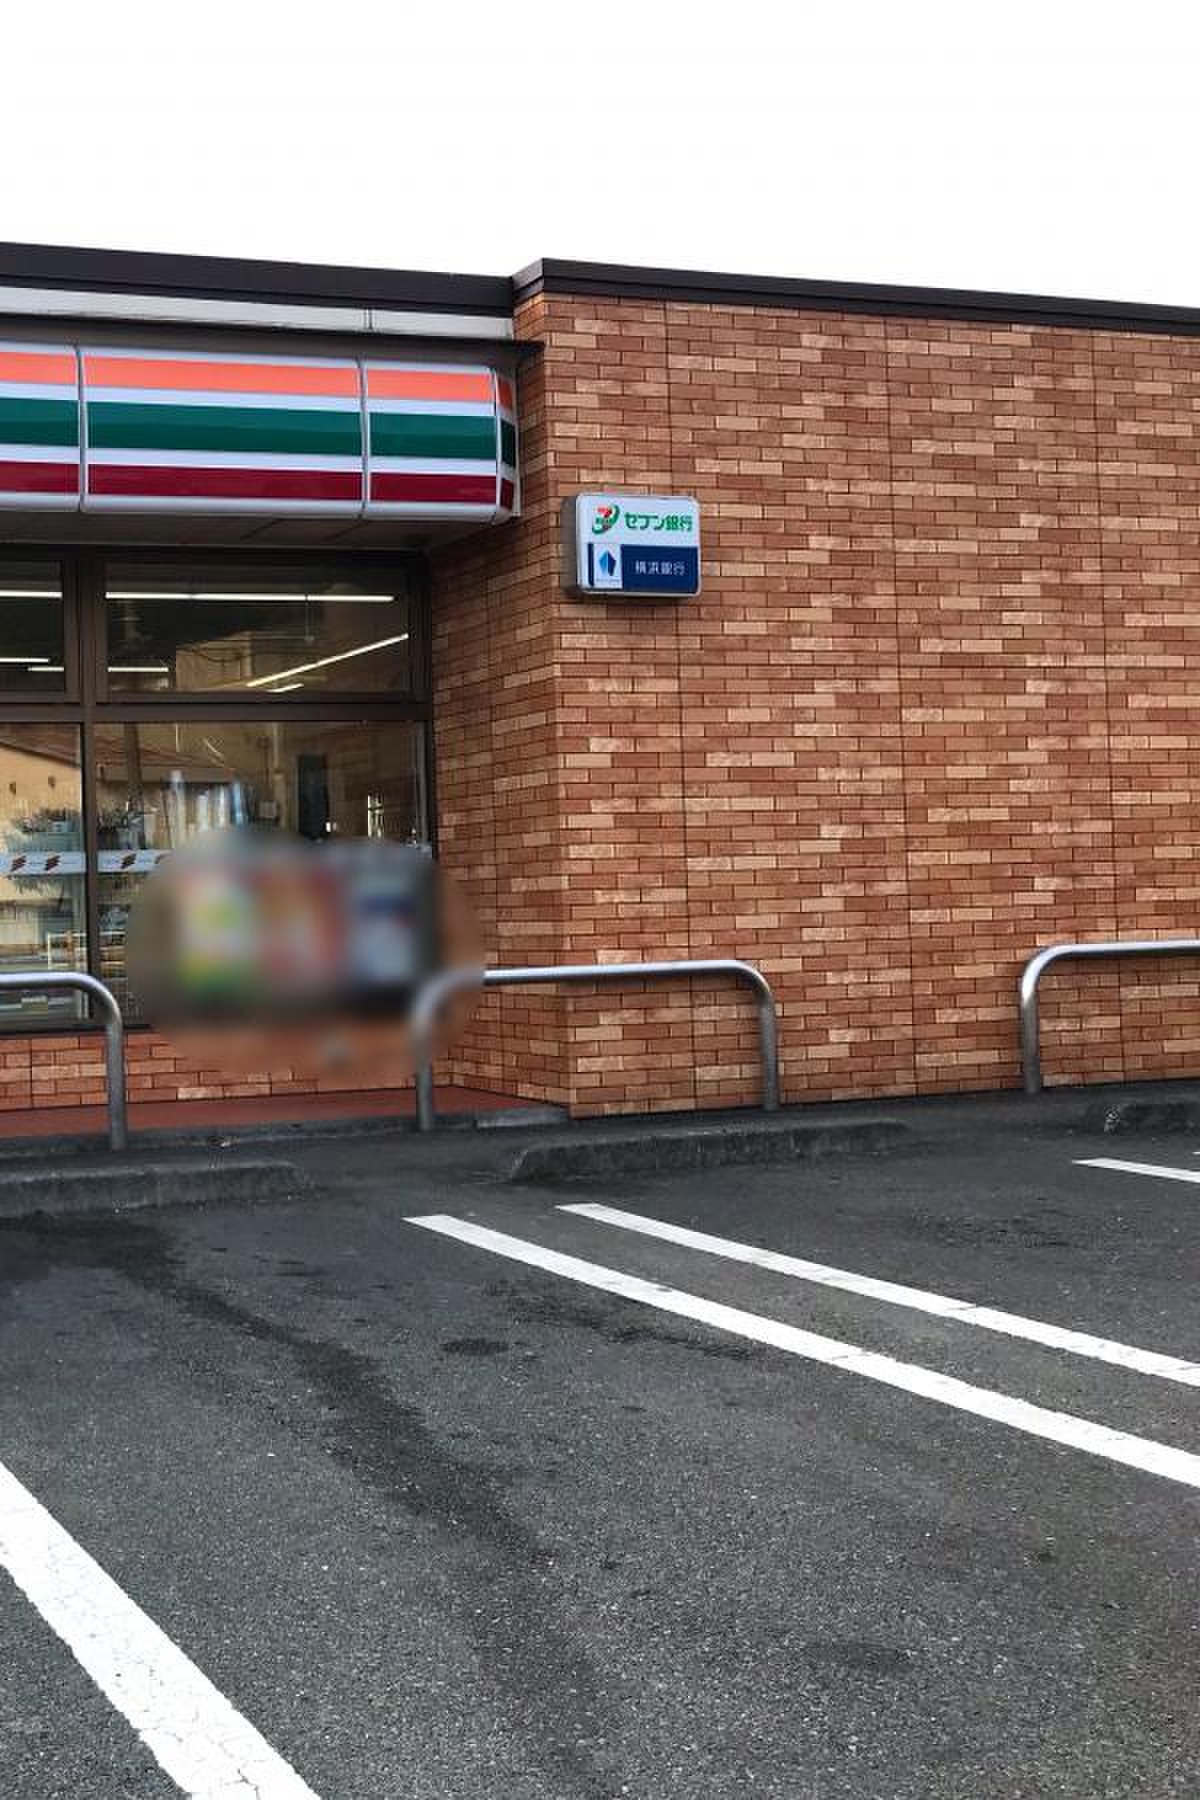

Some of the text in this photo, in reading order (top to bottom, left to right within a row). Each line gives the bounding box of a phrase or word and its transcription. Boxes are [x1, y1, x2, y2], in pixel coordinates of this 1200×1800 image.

[624, 512, 693, 532] セブン銀行
[635, 560, 686, 576] 横浜銀行
